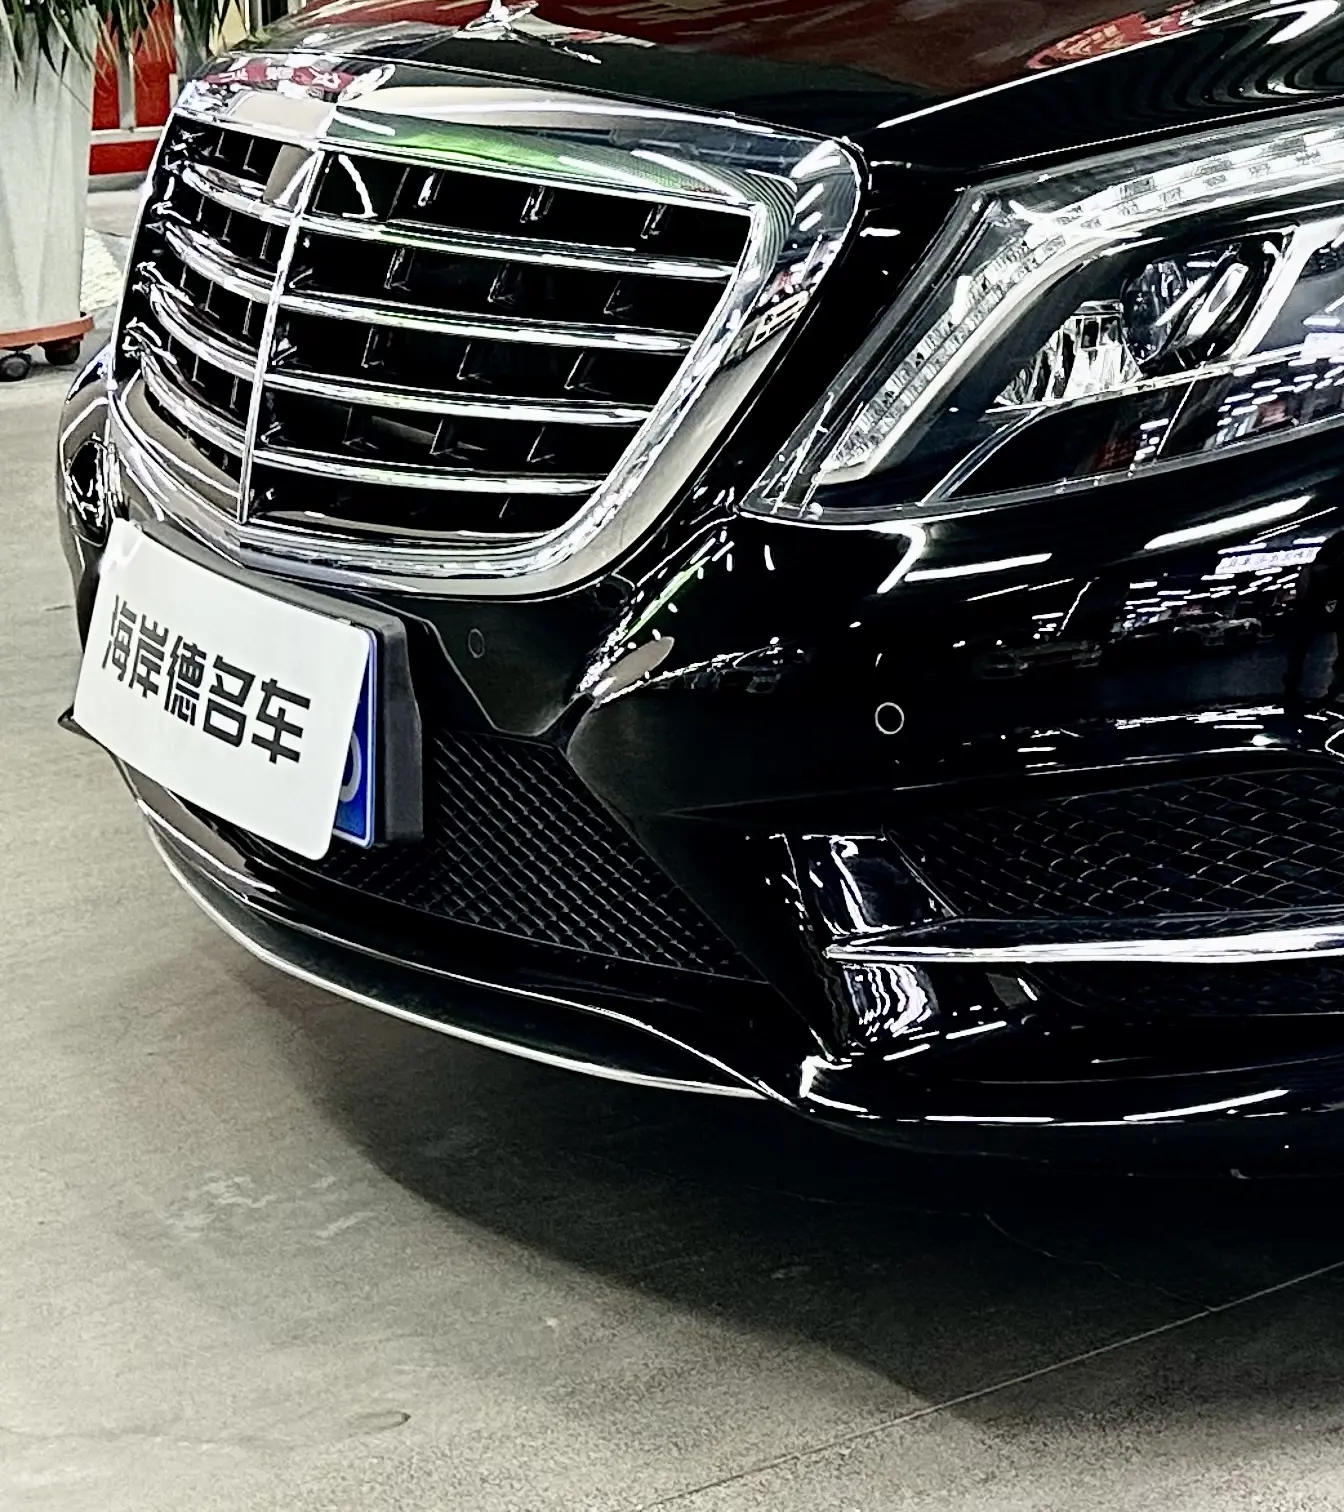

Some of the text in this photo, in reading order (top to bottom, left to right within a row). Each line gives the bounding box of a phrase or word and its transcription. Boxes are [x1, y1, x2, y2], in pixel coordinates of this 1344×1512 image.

[103, 594, 311, 765] 海岸德名车
